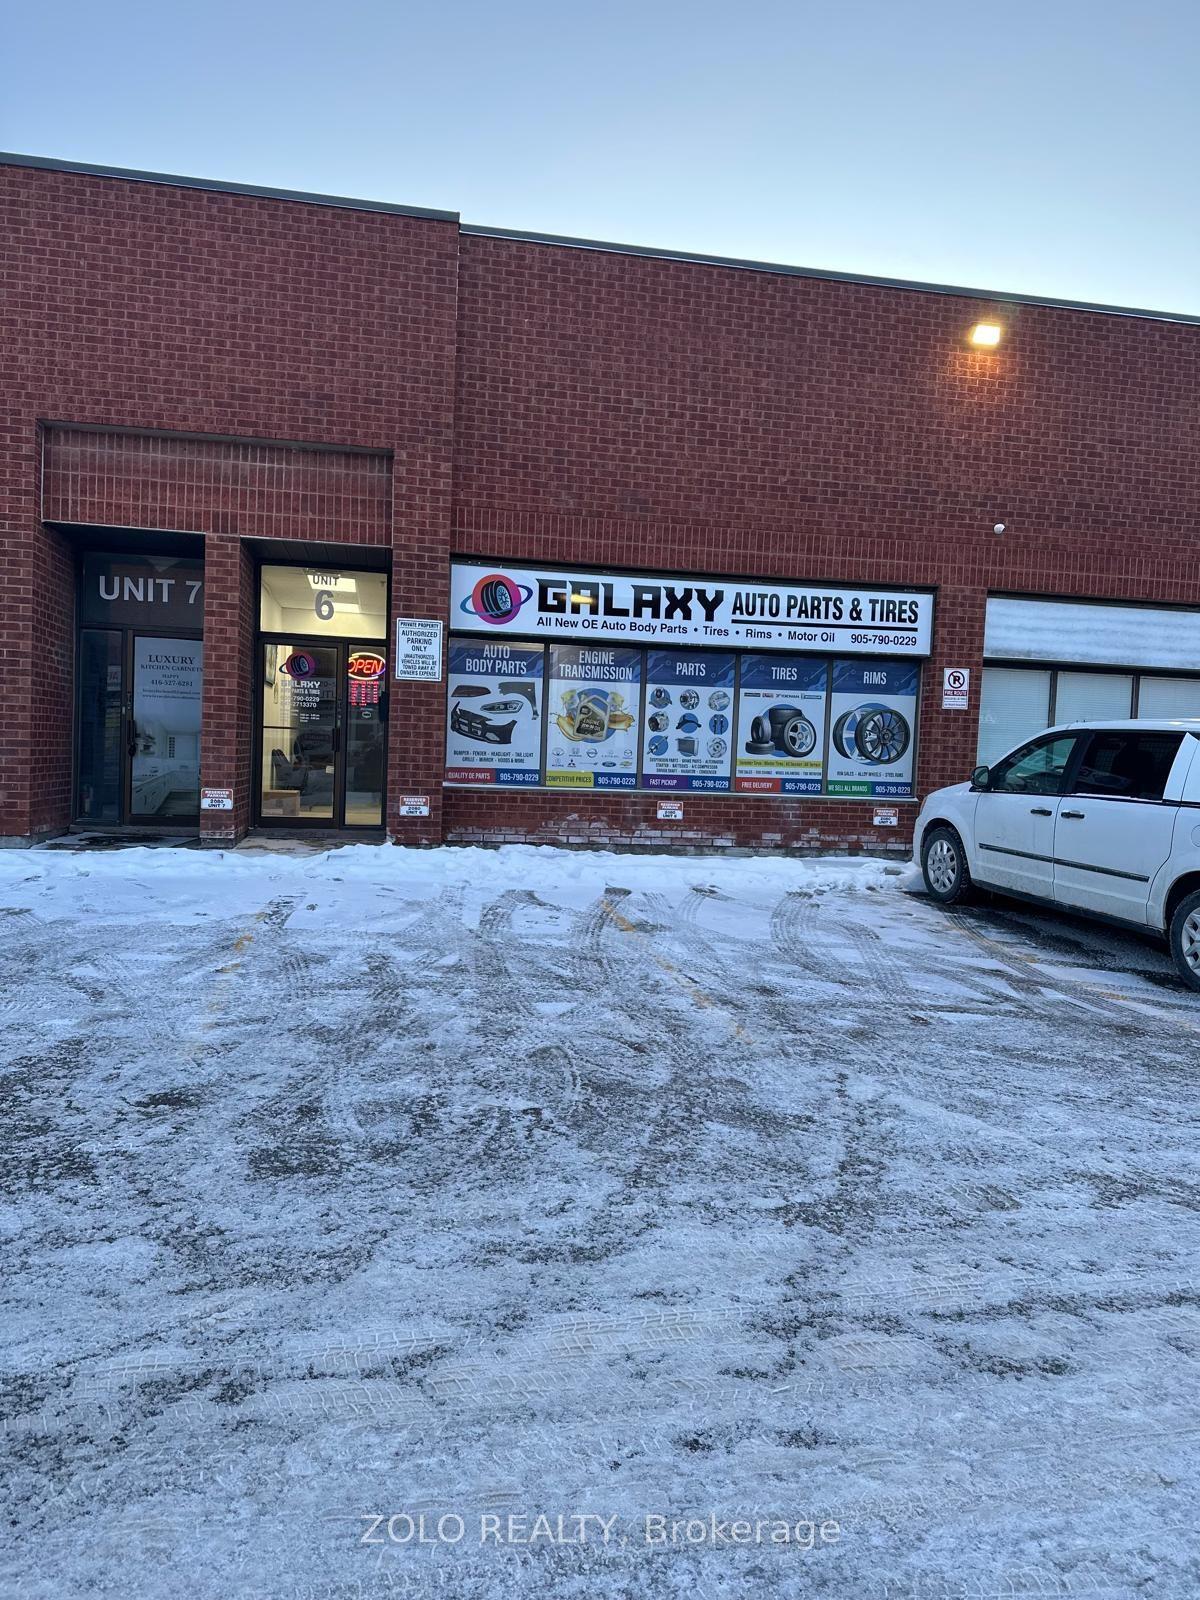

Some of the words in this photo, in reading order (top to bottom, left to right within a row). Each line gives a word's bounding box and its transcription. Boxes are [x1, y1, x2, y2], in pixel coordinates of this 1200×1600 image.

[312, 575, 340, 586] UNIT
[100, 576, 175, 602] UNIT
[186, 580, 202, 604] 7
[316, 590, 334, 620] 6
[536, 578, 724, 622] GALAXY
[732, 592, 779, 618] AUTO
[786, 595, 843, 620] PARTS
[850, 598, 862, 621] &
[869, 599, 918, 624] TIRES
[537, 617, 550, 626] All
[555, 618, 578, 628] New
[582, 619, 598, 629] OE
[600, 620, 626, 630] Auto
[630, 622, 657, 634] Body
[661, 624, 688, 634] Parts
[703, 626, 729, 637] Tires
[746, 628, 772, 639] Rims
[788, 631, 818, 642] Motor
[820, 632, 835, 643] Oil
[851, 634, 917, 646] 905-790-0229
[483, 644, 510, 658] AUTO
[579, 650, 615, 665] ENGINE
[148, 654, 196, 664] LUXURY
[348, 660, 382, 673] OPEN
[466, 659, 493, 672] BODY
[495, 660, 526, 674] PARTS
[559, 664, 633, 680] TRANSMISSION
[676, 662, 706, 676] PARTS
[772, 667, 798, 680] TIRES
[863, 671, 887, 684] RIMS
[500, 773, 539, 781] 905-790-0229
[598, 777, 636, 785] 905-790-0229
[692, 780, 728, 788] 905-790-0229
[875, 785, 910, 793] 905-790-0229
